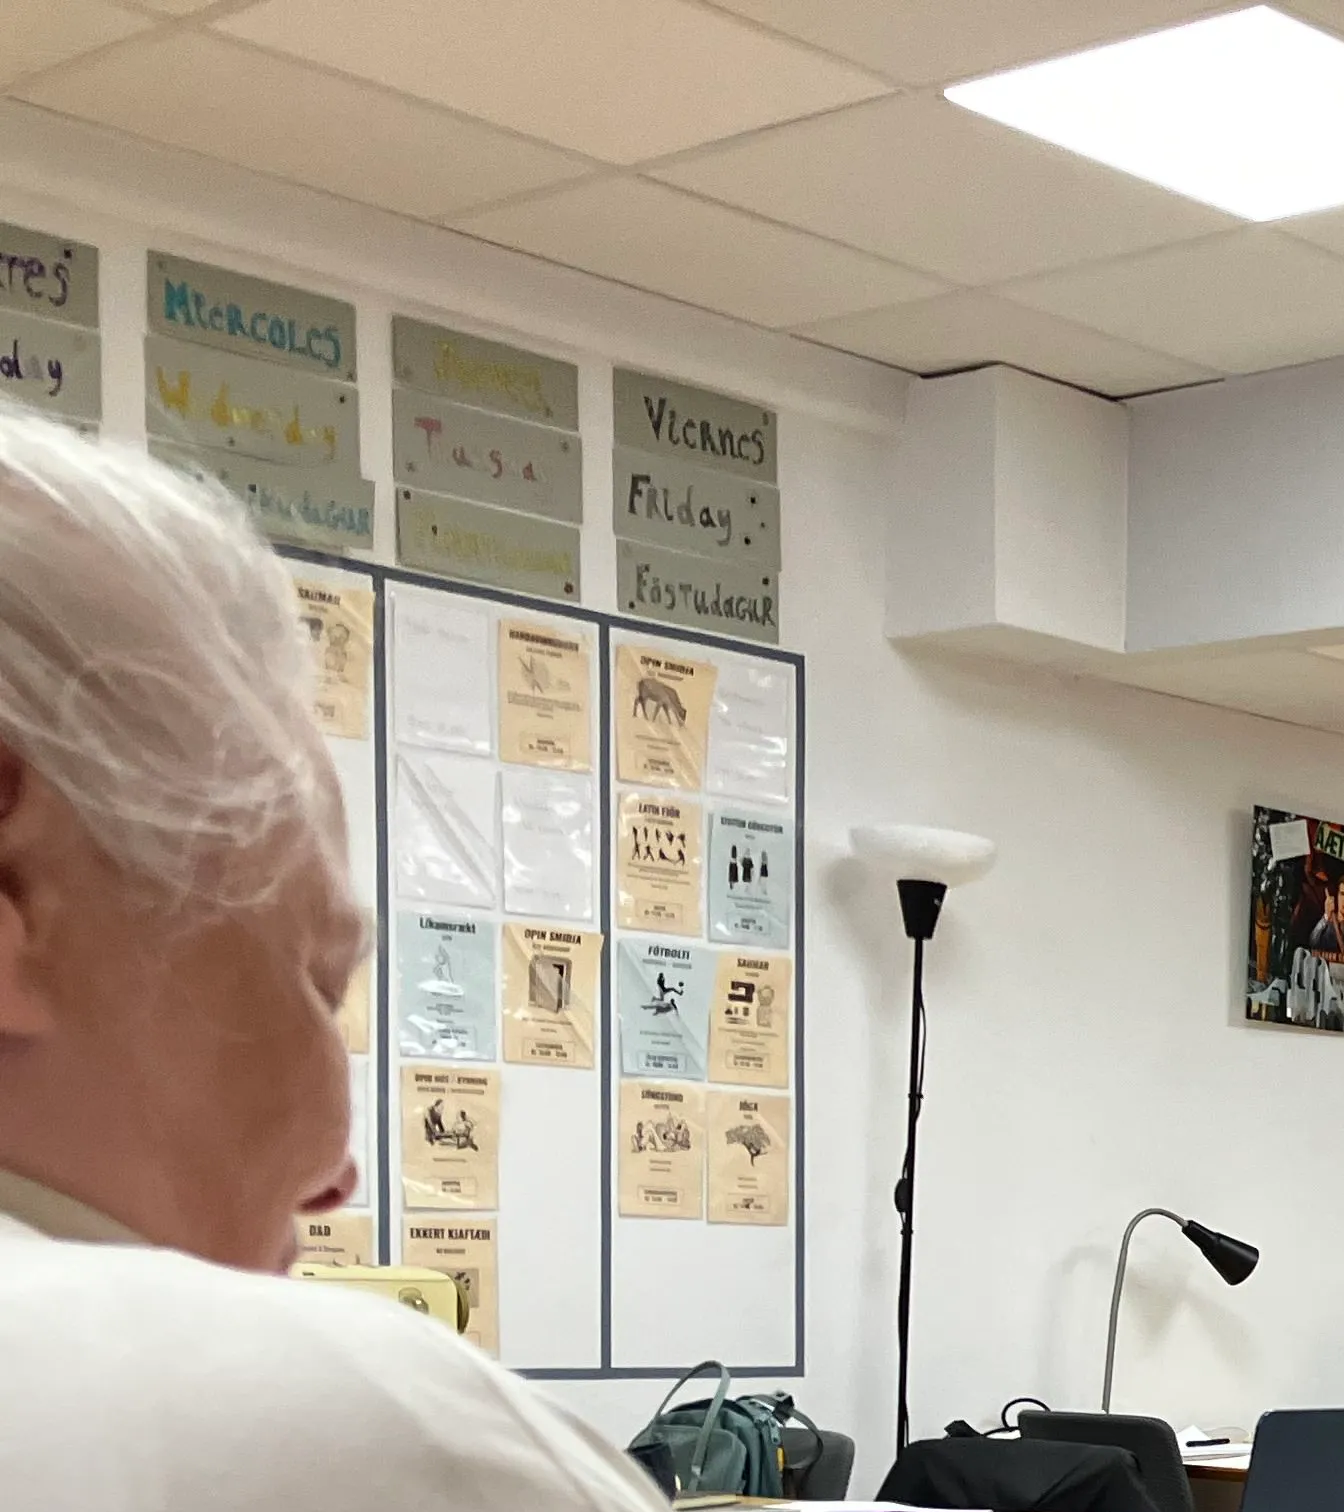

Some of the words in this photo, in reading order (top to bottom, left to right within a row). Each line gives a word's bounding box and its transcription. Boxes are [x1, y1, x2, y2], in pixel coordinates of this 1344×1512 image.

[524, 928, 547, 941] OPIN
[309, 1224, 331, 1237] D&D
[410, 1227, 445, 1240] EKKERT
